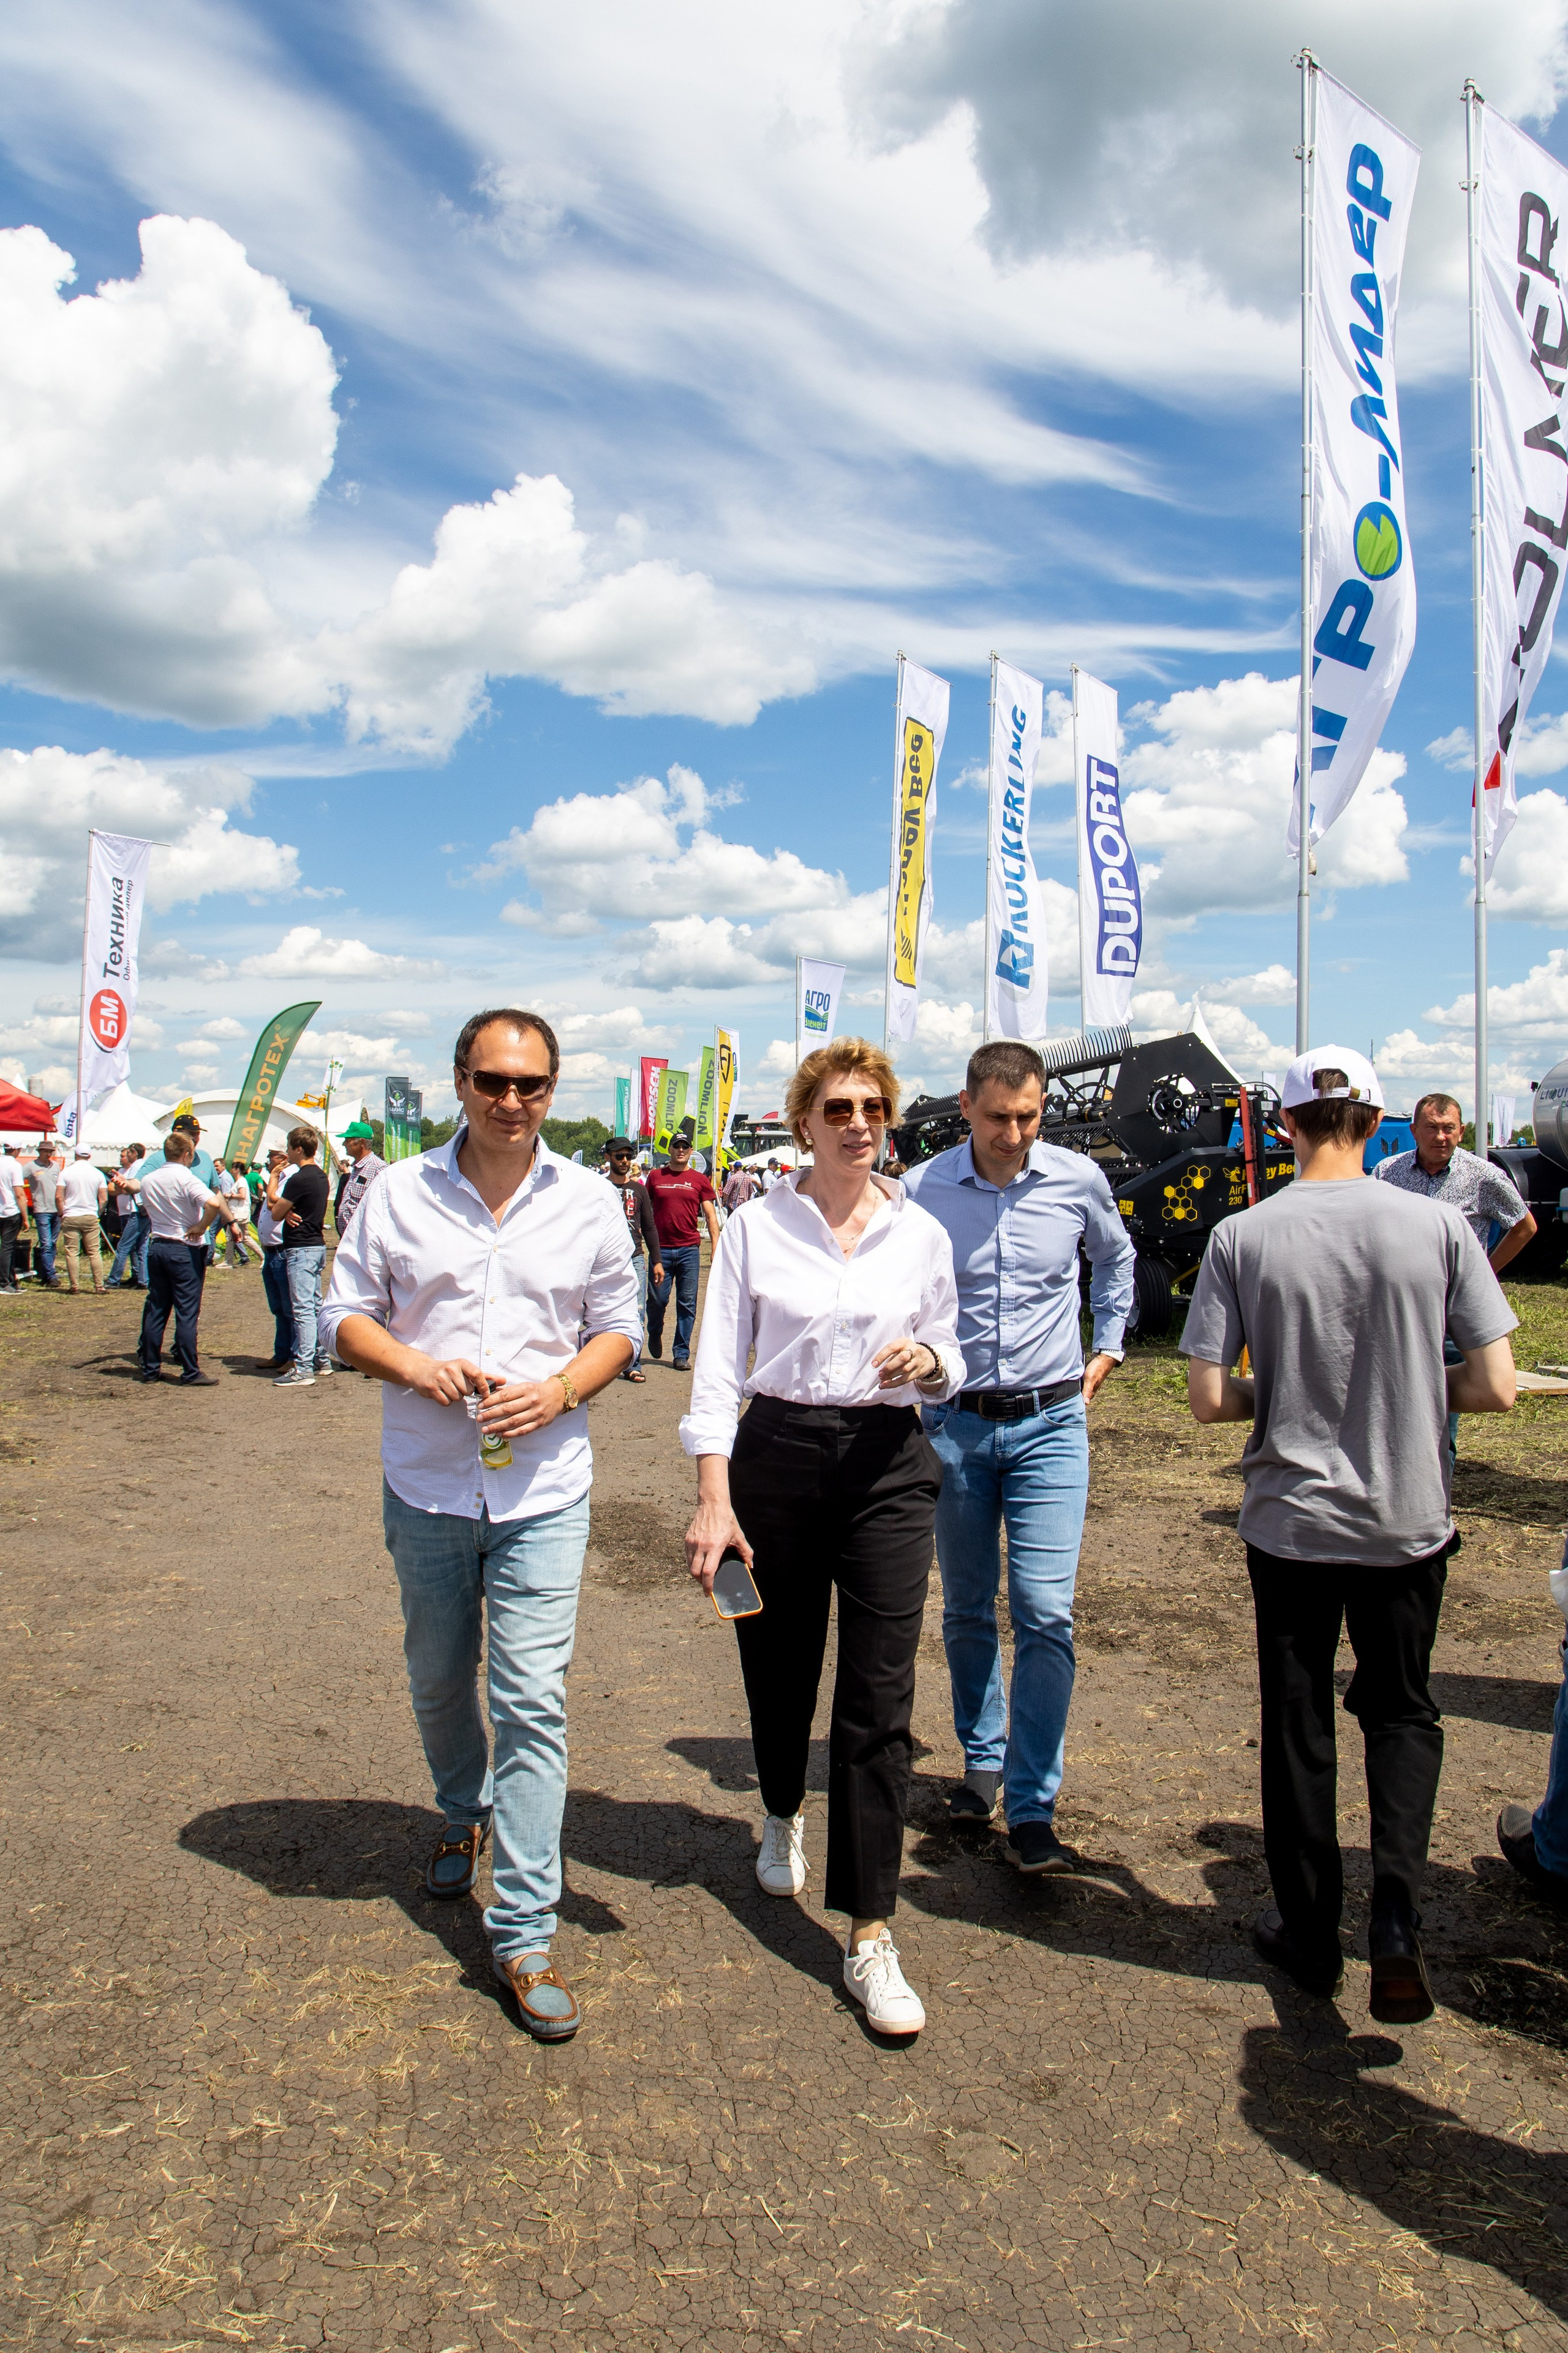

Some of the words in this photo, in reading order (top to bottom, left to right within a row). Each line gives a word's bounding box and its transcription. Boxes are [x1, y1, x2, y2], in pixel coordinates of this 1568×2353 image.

[1090, 758, 1139, 973] DUPORT
[103, 877, 124, 978] Техника
[100, 995, 119, 1038] БМ
[805, 989, 831, 1011] АГРО
[649, 1066, 660, 1130] HORSCH
[665, 1079, 678, 1131] ZOOMLIO
[697, 1059, 715, 1135] ZOOMLION
[1228, 1196, 1242, 1206] 230
[1229, 1184, 1247, 1196] AirF
